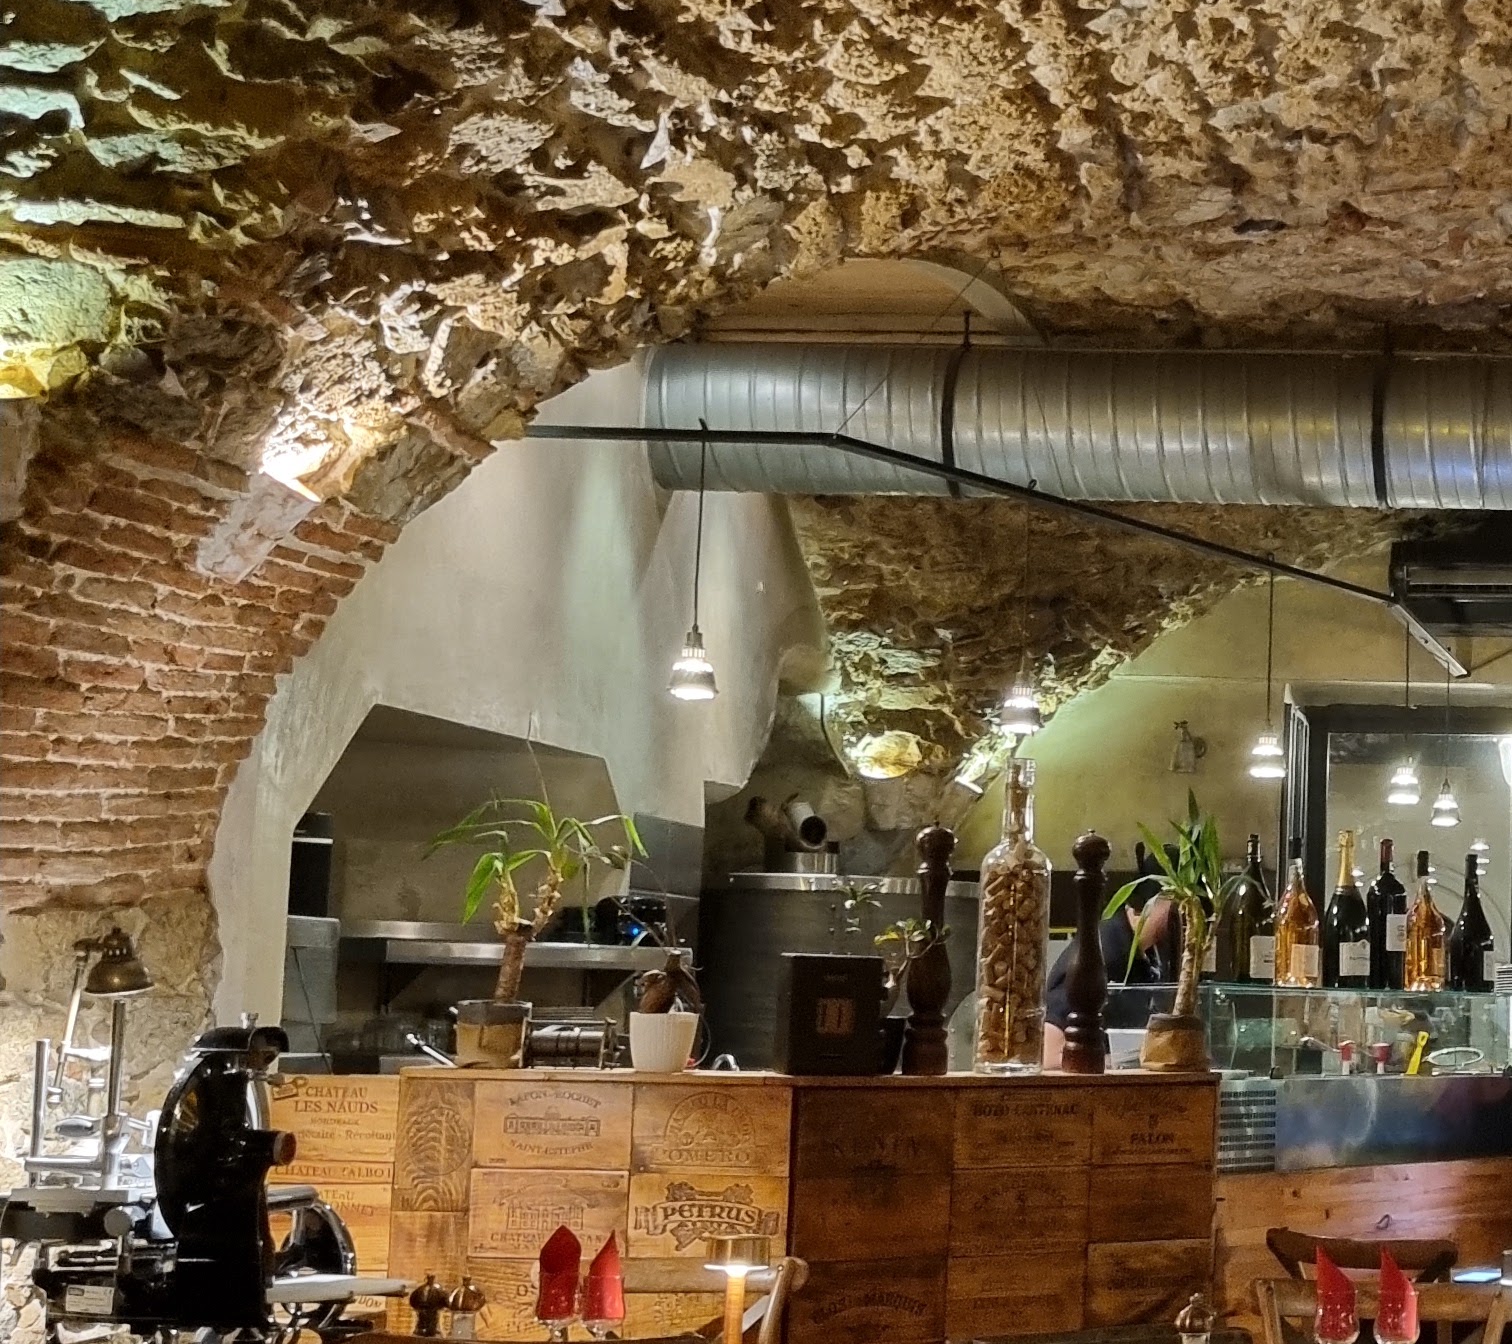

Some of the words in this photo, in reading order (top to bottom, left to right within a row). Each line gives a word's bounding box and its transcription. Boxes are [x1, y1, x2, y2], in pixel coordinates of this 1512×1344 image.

[305, 1086, 368, 1099] CHATEAU
[294, 1100, 321, 1113] LES
[660, 1204, 756, 1224] PETRUS
